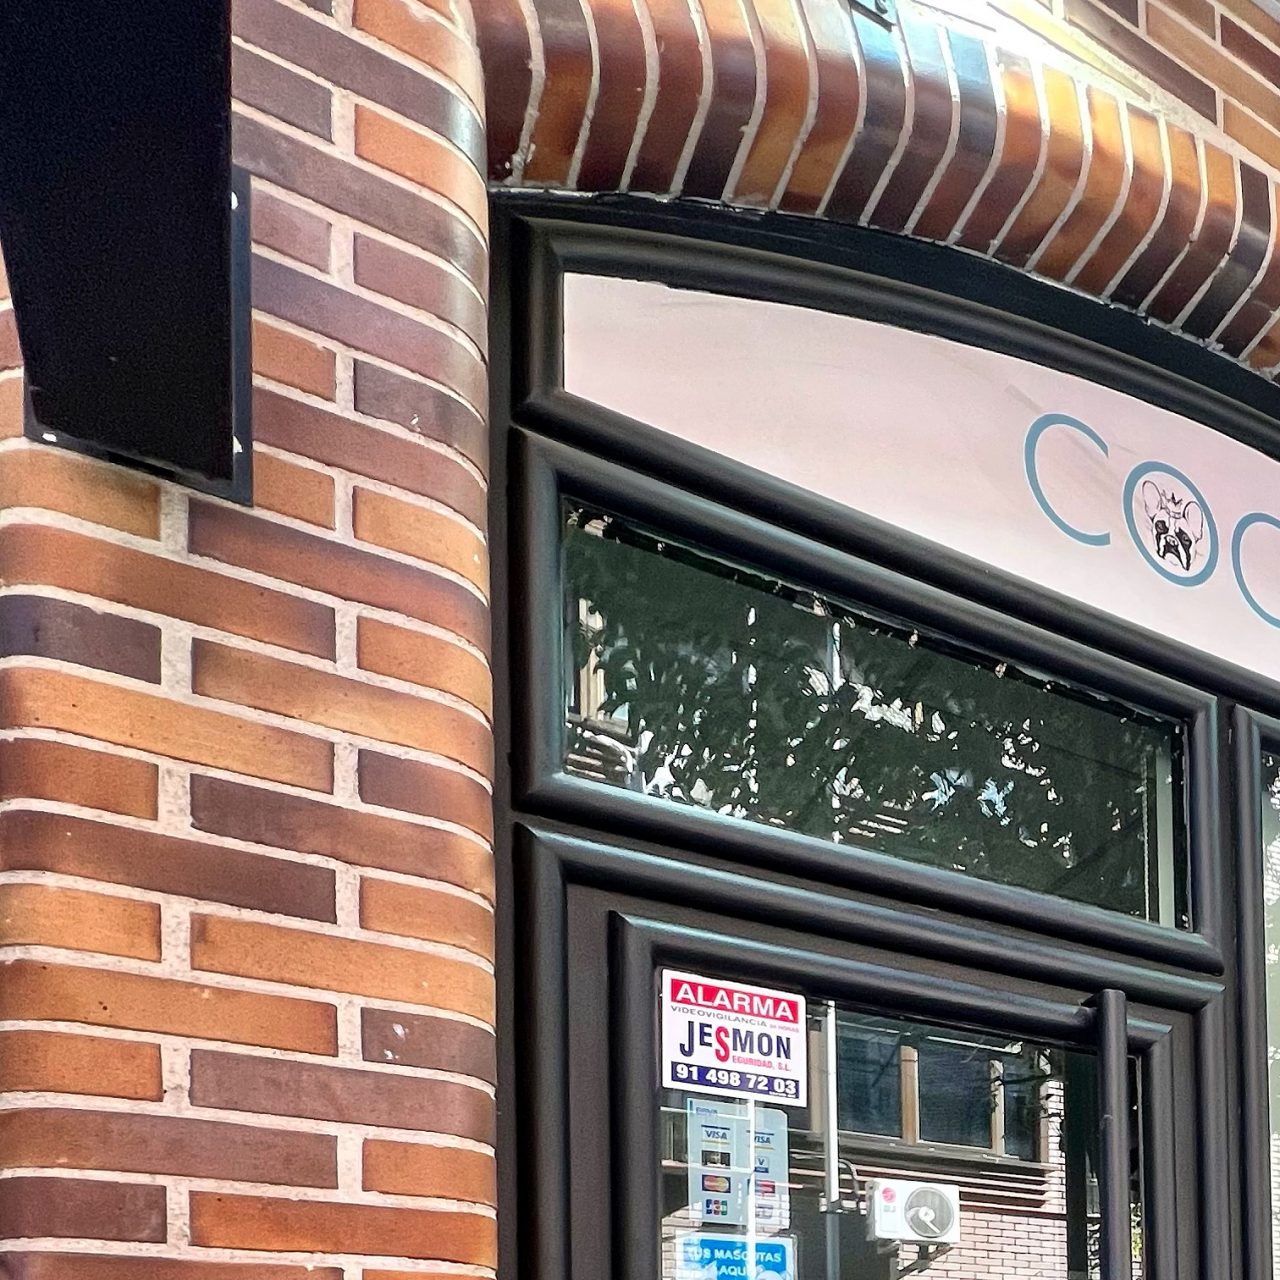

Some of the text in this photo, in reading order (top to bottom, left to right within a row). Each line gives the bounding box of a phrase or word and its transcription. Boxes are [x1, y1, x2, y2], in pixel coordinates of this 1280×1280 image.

[675, 983, 795, 1020] ALARMA
[670, 1005, 768, 1028] VIDEOVIGILANCIA
[679, 1020, 792, 1062] JESMON
[676, 1063, 797, 1095] 91 498 72 03
[705, 1129, 728, 1141] VISA
[714, 1248, 782, 1263] MASCTAS
[719, 1265, 750, 1277] AQU
